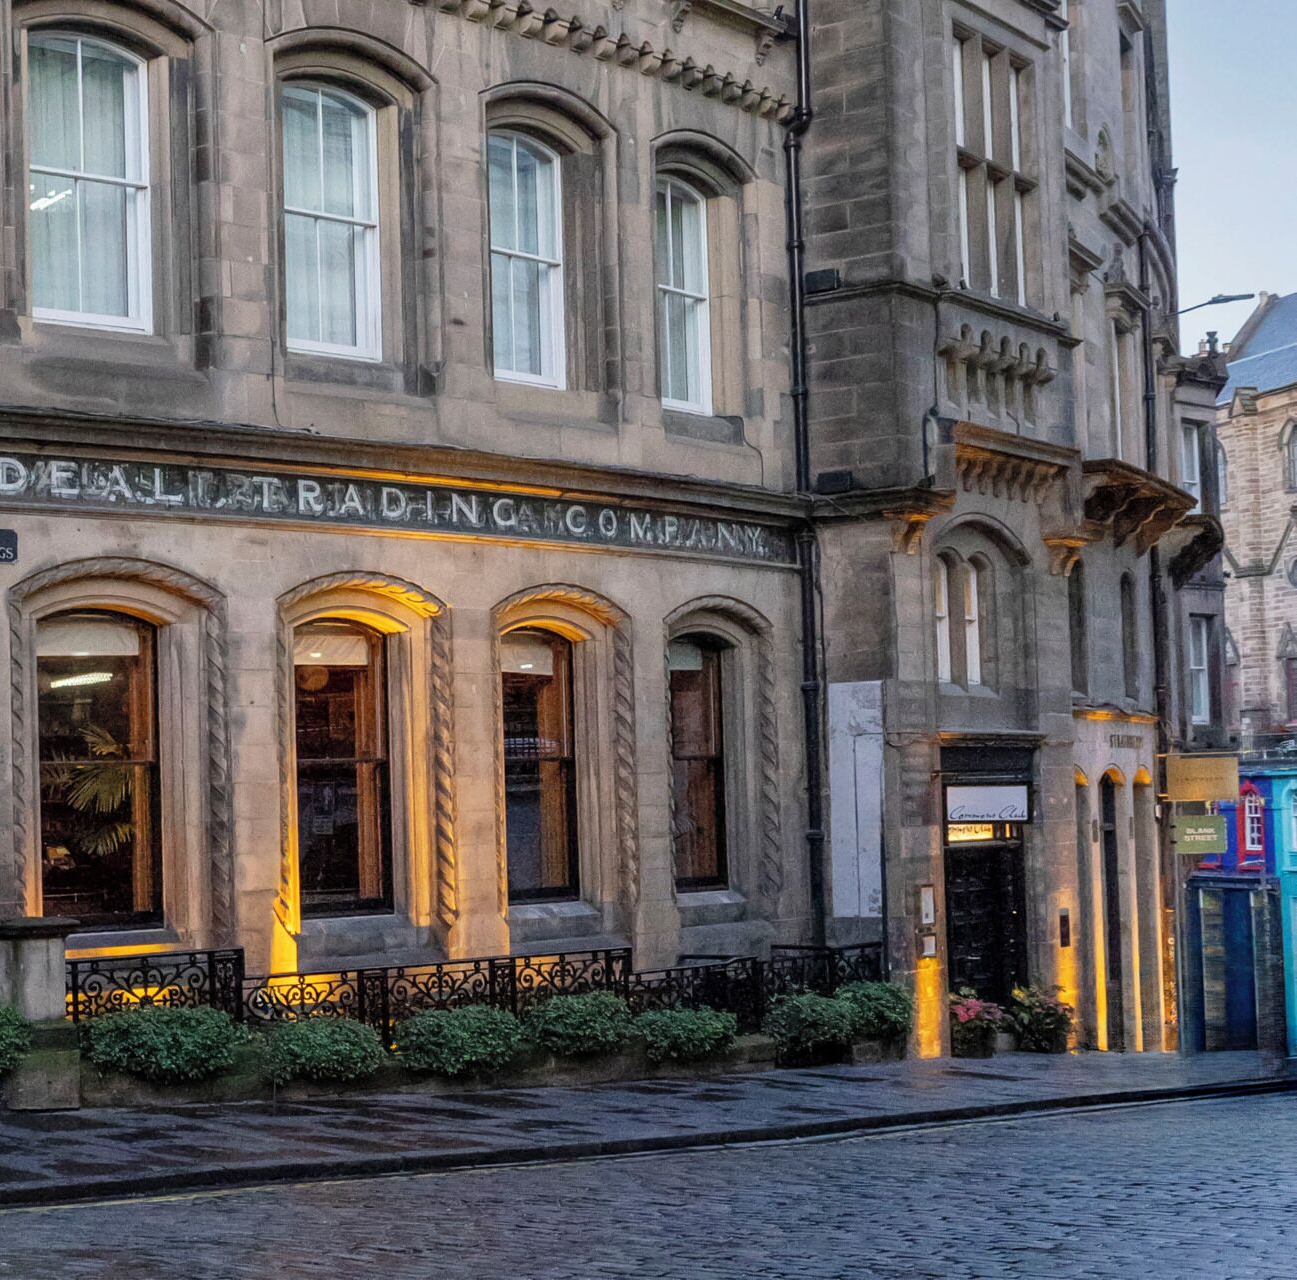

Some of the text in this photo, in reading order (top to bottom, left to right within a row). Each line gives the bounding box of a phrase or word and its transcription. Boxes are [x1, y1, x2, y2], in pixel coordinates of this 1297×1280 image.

[252, 475, 519, 528] TRADING
[565, 504, 769, 556] COMPANY
[1185, 827, 1217, 835] BLANK
[1183, 834, 1218, 842] STREET
